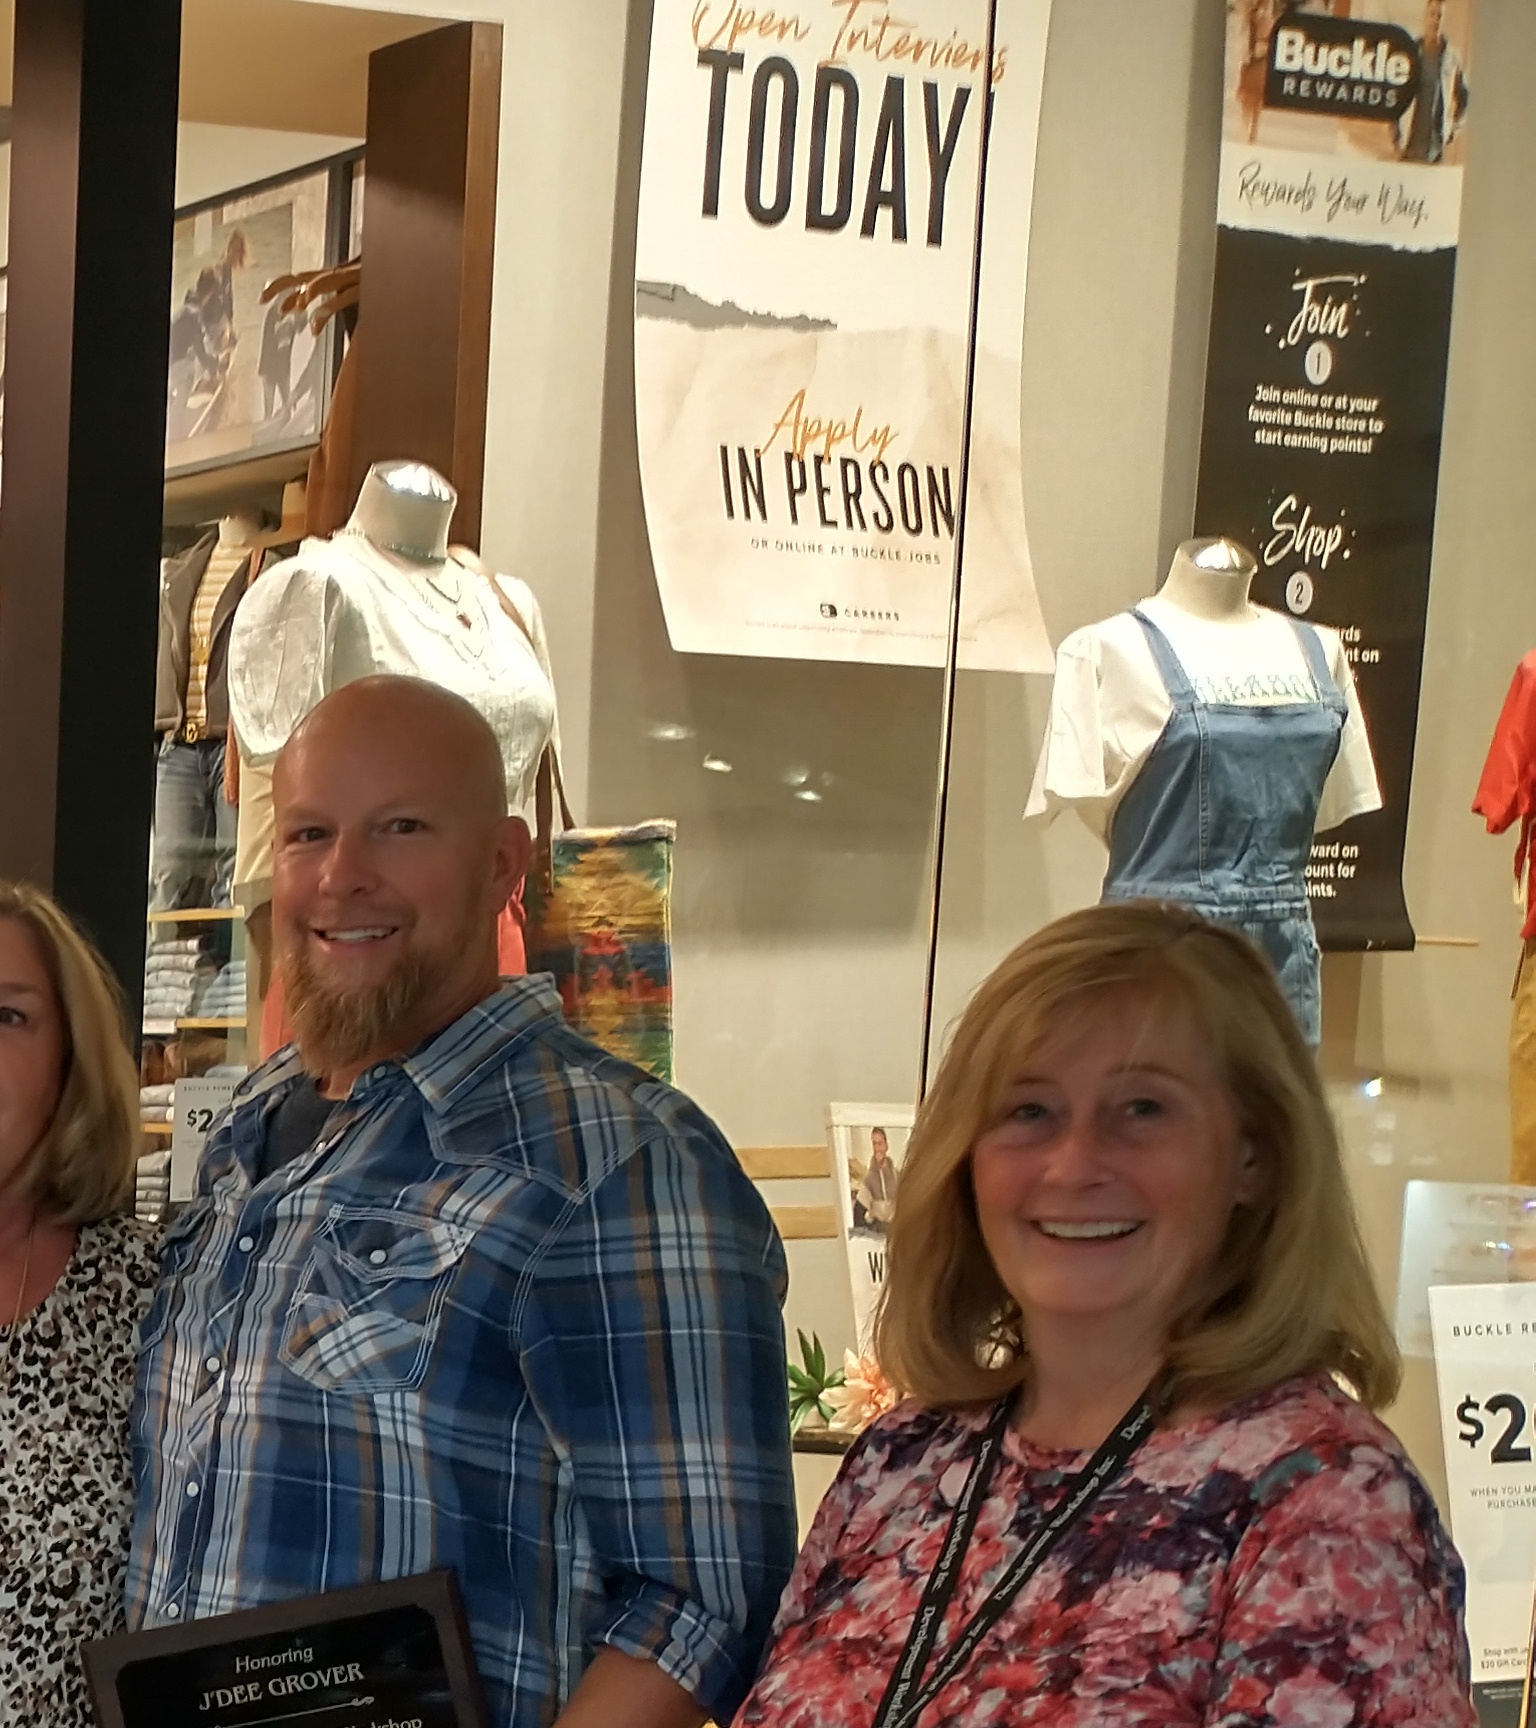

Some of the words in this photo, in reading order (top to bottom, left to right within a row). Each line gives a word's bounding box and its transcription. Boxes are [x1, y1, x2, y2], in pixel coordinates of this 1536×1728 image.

[692, 0, 810, 54] Open
[1275, 24, 1412, 86] Buckle
[1282, 77, 1399, 108] REWARDS
[697, 49, 972, 249] TODAY
[1238, 160, 1316, 214] Rewards
[1326, 174, 1370, 224] Your
[1288, 274, 1358, 346] Join
[1255, 384, 1281, 403] Join
[1282, 388, 1319, 408] online
[1320, 393, 1334, 409] or
[1335, 394, 1348, 411] at
[1348, 397, 1379, 414] your
[759, 388, 900, 466] Apply
[1248, 402, 1293, 426] favorite
[1294, 409, 1334, 430] Buckle
[1335, 416, 1367, 433] store
[1368, 417, 1384, 434] to
[1254, 427, 1283, 446] start
[1283, 431, 1328, 454] earning
[1329, 435, 1373, 454] points!
[719, 445, 768, 523] IN
[784, 448, 956, 541] PERSON
[751, 537, 769, 550] OR
[775, 540, 825, 556] ONLINE
[831, 545, 845, 557] AT
[1264, 493, 1343, 570] Shop
[1295, 582, 1304, 604] 2
[844, 608, 900, 623] CAREERS
[1340, 625, 1361, 643] rds
[1361, 649, 1379, 663] on
[1310, 842, 1340, 858] ward
[1342, 845, 1359, 858] on
[1305, 862, 1335, 878] ount
[1337, 861, 1356, 878] for
[186, 1108, 214, 1133] $2
[867, 1251, 884, 1284] W
[1453, 1322, 1513, 1337] BUCKLE
[1456, 1393, 1532, 1465] $2
[1470, 1487, 1499, 1498] WHEN
[1501, 1485, 1522, 1496] YOU
[901, 1605, 936, 1680] Development
[235, 1647, 314, 1675] Honoring
[199, 1681, 263, 1711] J'DEE
[268, 1662, 365, 1697] GROVER
